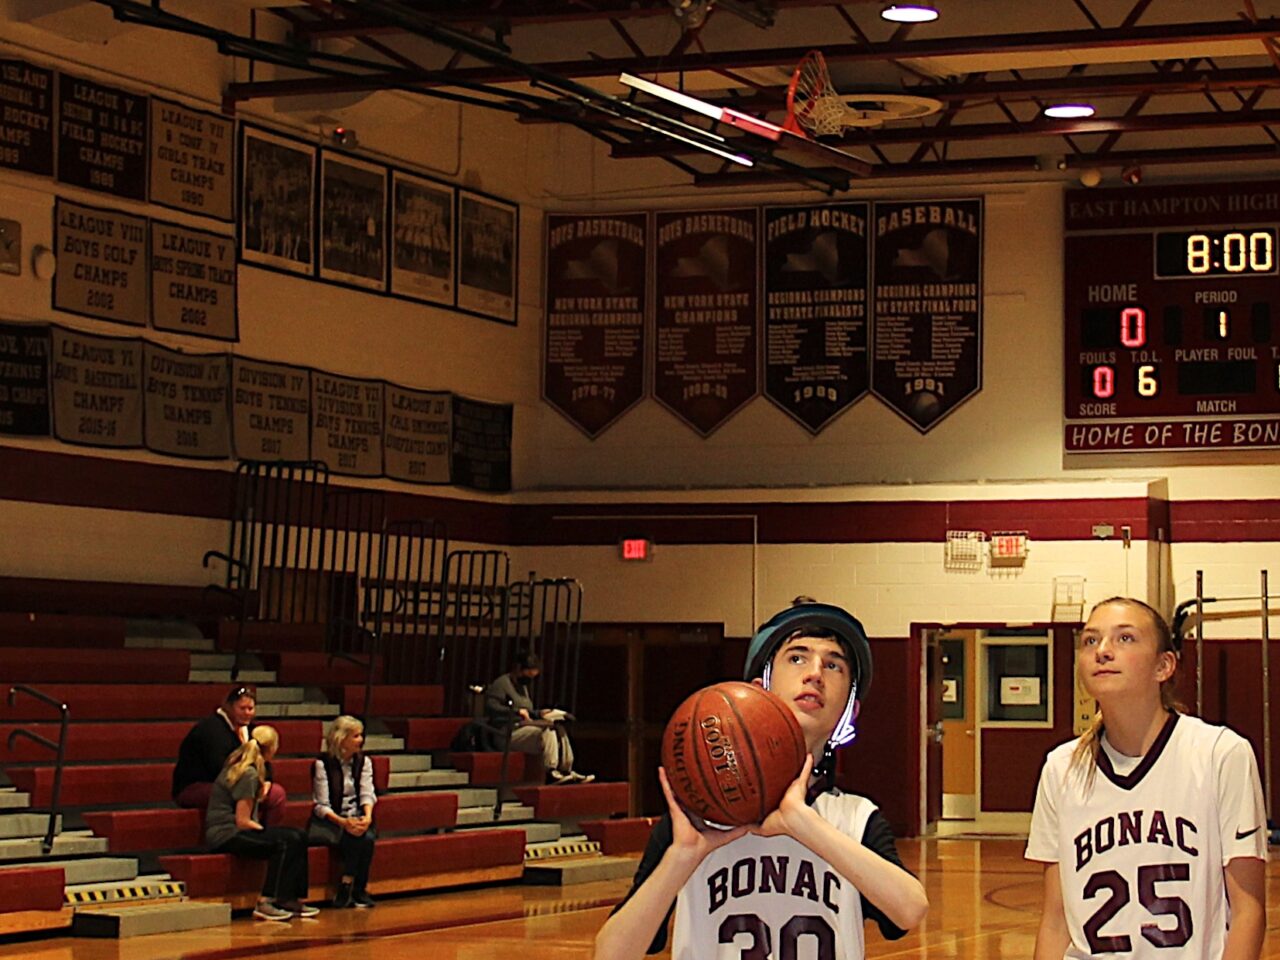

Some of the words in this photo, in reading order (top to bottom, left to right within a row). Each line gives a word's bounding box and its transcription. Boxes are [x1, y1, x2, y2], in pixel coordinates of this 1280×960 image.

[74, 84, 118, 110] LEAGUE
[161, 109, 204, 133] LEAGUE
[62, 120, 95, 143] FIELD
[100, 131, 144, 156] HOCKEY
[80, 147, 124, 171] CHAMPS
[157, 145, 188, 166] GIRLS
[192, 155, 225, 176] TRACK
[170, 167, 214, 191] CHAMPS
[1070, 201, 1117, 219] EAST
[1122, 194, 1221, 216] HAMPTON
[1227, 192, 1279, 213] HIGH
[60, 211, 115, 238] LEAGUE
[577, 219, 644, 247] BASKETBALL
[685, 215, 754, 242] BASKETBALL
[768, 211, 806, 241] FIELD
[810, 209, 864, 238] HOCKEY
[877, 205, 978, 238] BASEBALL
[63, 235, 100, 259] BOYS
[104, 244, 139, 266] GOLF
[162, 233, 212, 258] LEAGUE
[217, 245, 227, 262] V
[1187, 231, 1274, 275] 8:00
[73, 262, 129, 288] CHAMPS
[86, 289, 115, 311] 2002
[168, 282, 218, 306] CHAMPS
[664, 295, 686, 309] NEW
[688, 294, 714, 308] YORK
[716, 293, 749, 307] STATE
[768, 290, 812, 305] REGIONAL
[813, 288, 865, 303] CHAMPIONS
[877, 284, 921, 298] REGIONAL
[923, 283, 976, 297] CHAMPIONS
[1088, 284, 1138, 302] HOME
[1194, 289, 1239, 305] PERIOD
[555, 297, 575, 311] NEW
[577, 297, 603, 311] YORK
[605, 296, 638, 311] STATE
[769, 306, 781, 320] NY
[783, 306, 813, 320] STATE
[890, 299, 921, 313] STATE
[922, 299, 951, 313] FINAL
[180, 307, 208, 327] 2002
[674, 309, 738, 324] CHAMPIONS
[1119, 306, 1148, 350] 0
[1218, 310, 1229, 339] 1
[62, 340, 117, 366] LEAGUE
[1079, 351, 1118, 366] FOULS
[1174, 348, 1219, 363] PLAYER
[1227, 346, 1259, 361] FOUL
[146, 376, 177, 400] BOYS
[239, 366, 287, 390] DIVISION
[316, 378, 361, 401] LEAGUE
[904, 377, 945, 397] 1991
[1092, 364, 1116, 400] 0
[1136, 363, 1159, 398] 6
[236, 386, 264, 408] BOYS
[268, 394, 309, 415] TENNIS
[318, 395, 363, 418] DIVISION
[392, 392, 432, 415] LEAGUE
[1078, 402, 1119, 417] SCORE
[1196, 398, 1238, 413] MATCH
[249, 413, 294, 435] CHAMPS
[316, 412, 341, 432] BOYS
[1072, 424, 1135, 447] HOME
[1145, 423, 1175, 446] OF
[1181, 421, 1224, 444] THE
[327, 432, 369, 453] CHAMPS
[1073, 808, 1200, 873] BONAC
[707, 855, 841, 915] BONAC
[1081, 862, 1195, 956] 25
